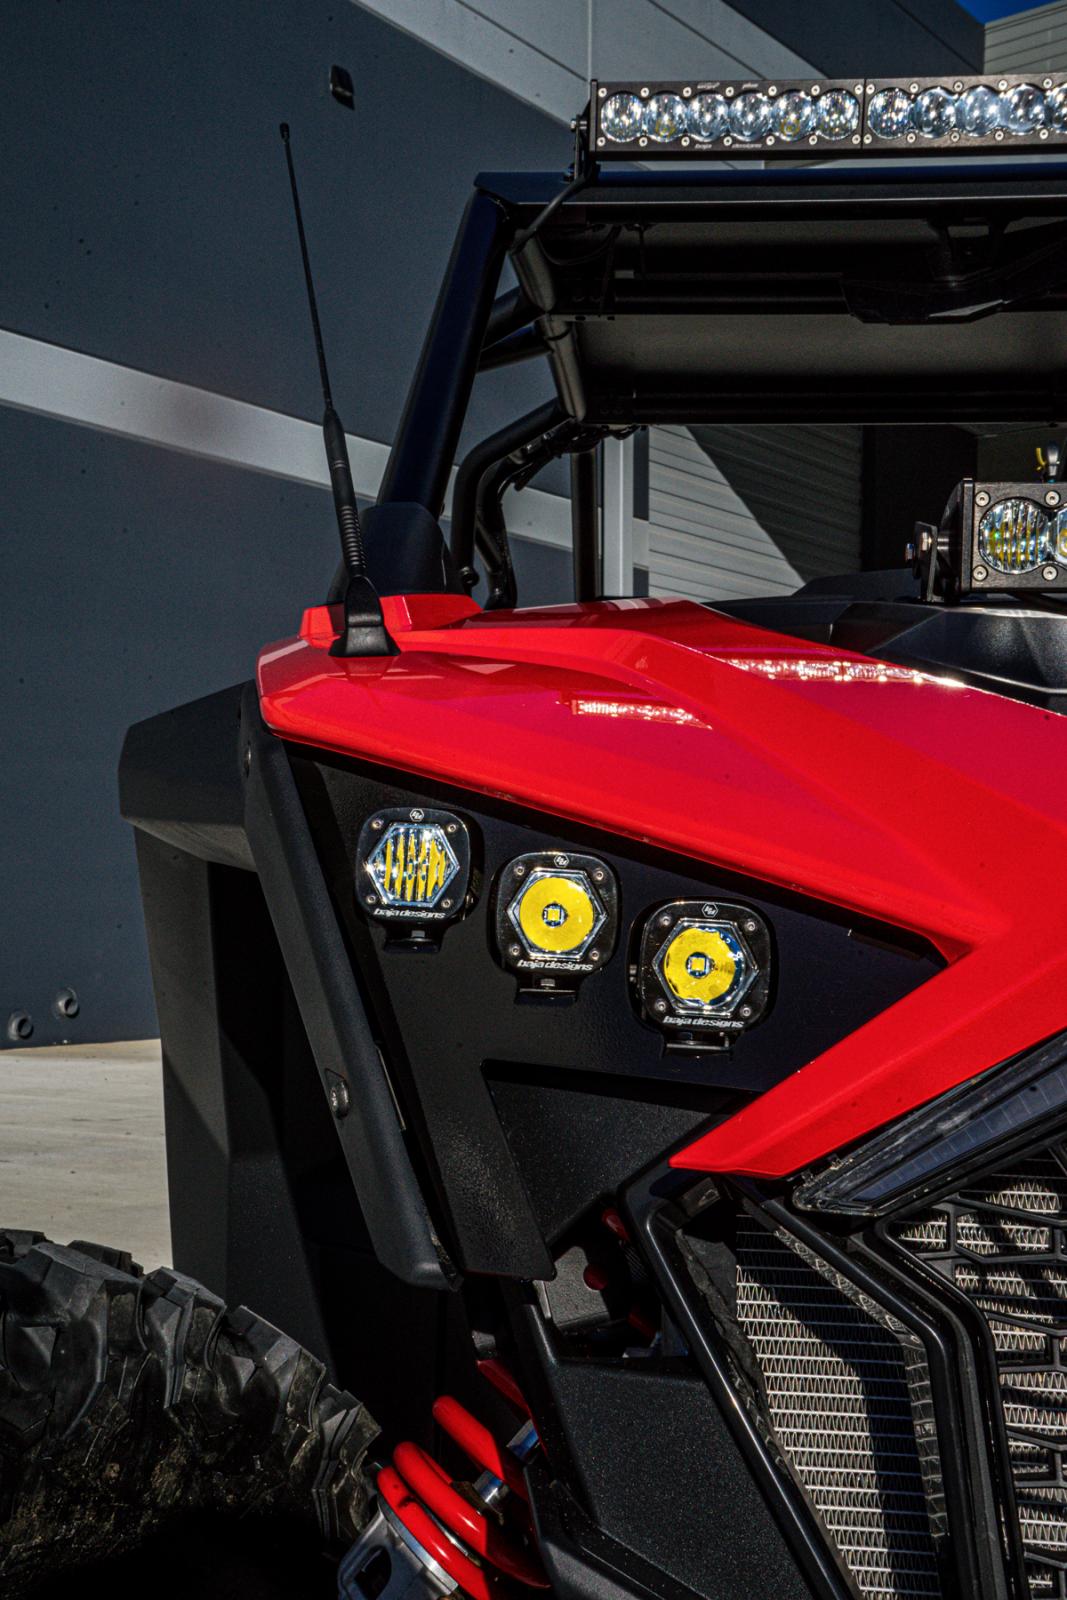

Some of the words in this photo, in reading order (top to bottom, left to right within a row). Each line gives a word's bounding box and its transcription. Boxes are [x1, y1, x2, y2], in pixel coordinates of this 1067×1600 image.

[373, 908, 400, 917] baja
[399, 909, 447, 919] designs
[517, 959, 545, 969] baja
[544, 960, 593, 971] designs
[662, 1016, 692, 1026] baja
[692, 1017, 745, 1028] designs
